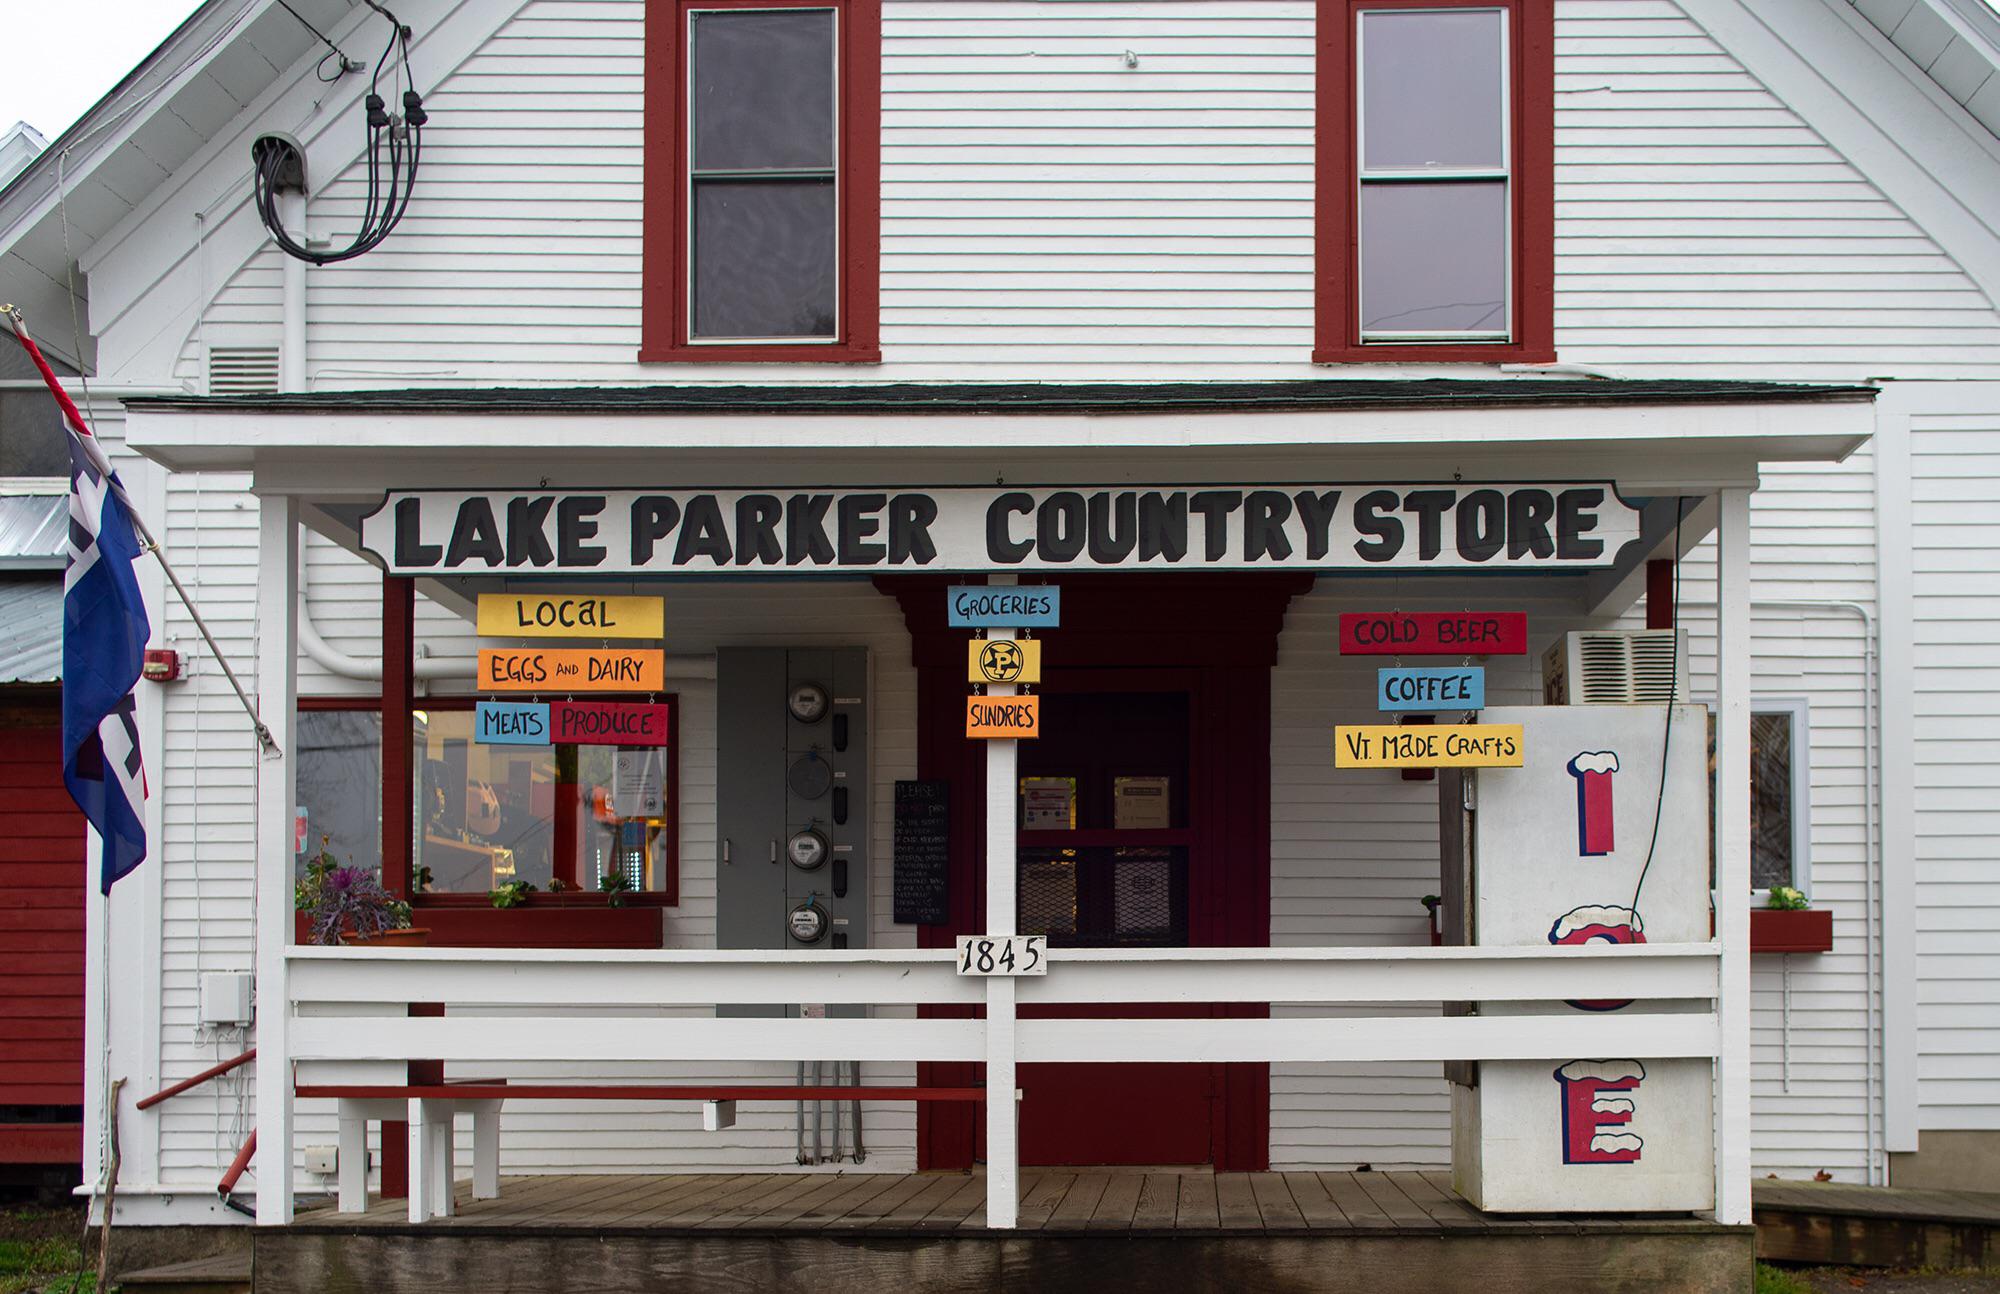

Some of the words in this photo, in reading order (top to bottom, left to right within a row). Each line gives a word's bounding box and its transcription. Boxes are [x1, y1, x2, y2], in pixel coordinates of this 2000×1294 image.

[394, 495, 608, 568] LAKE
[630, 493, 939, 567] PARKER
[985, 489, 1342, 565] COUNTRY
[1353, 488, 1606, 563] STORE
[955, 592, 1051, 621] GROCERIES
[1353, 618, 1420, 645] COLD
[1437, 619, 1501, 644] BEER
[491, 655, 547, 683] EGGS
[555, 662, 579, 677] AND
[588, 656, 644, 682] DAIRY
[1385, 675, 1472, 703] COFFEE
[484, 709, 543, 736] MEATS
[561, 707, 654, 737] PRODUCE
[970, 703, 1035, 729] SUNDRIES
[961, 937, 1039, 973] 1845
